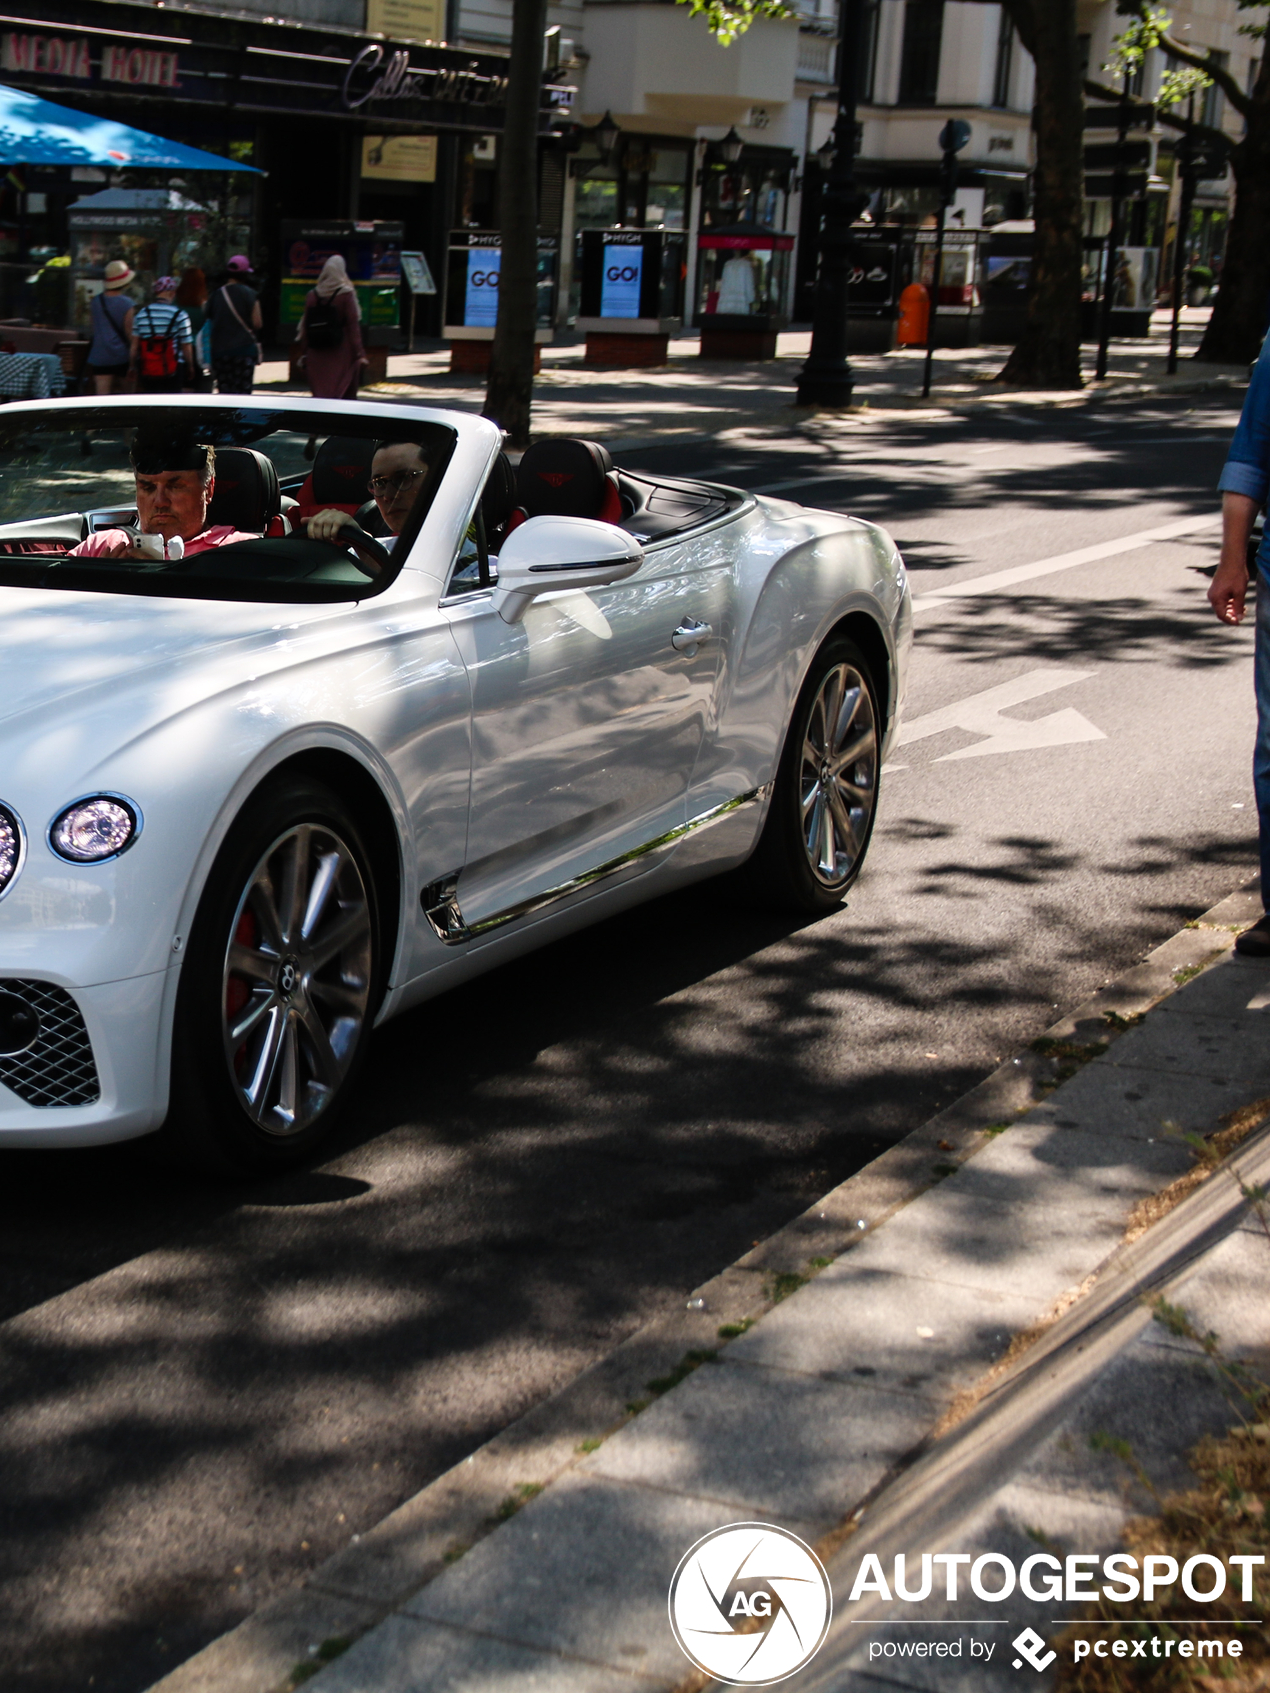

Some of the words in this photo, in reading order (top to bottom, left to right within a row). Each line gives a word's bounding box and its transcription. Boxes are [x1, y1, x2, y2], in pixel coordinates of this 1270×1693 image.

[0, 32, 91, 78] MEDIA
[101, 45, 182, 87] HOTEL
[479, 235, 502, 245] HYG
[471, 270, 500, 287] GO
[607, 266, 639, 283] GO!
